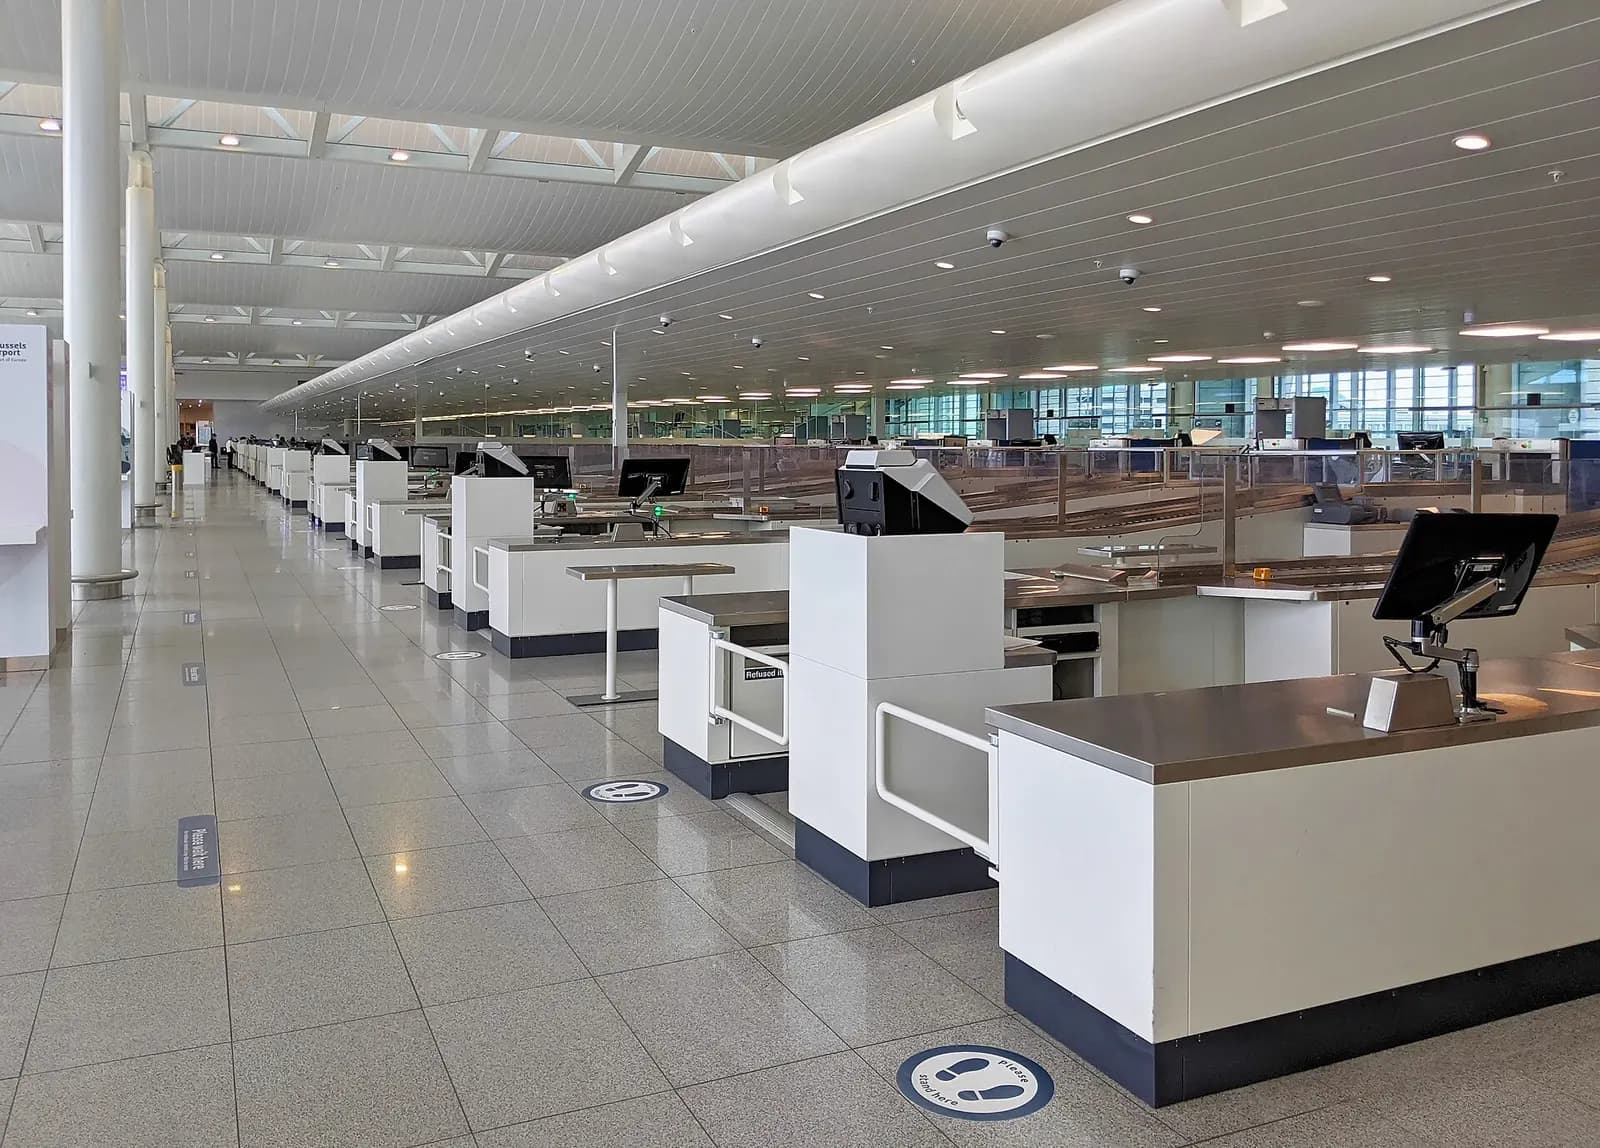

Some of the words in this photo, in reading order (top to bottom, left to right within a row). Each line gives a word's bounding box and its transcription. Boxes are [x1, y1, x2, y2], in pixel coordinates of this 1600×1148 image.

[746, 669, 776, 679] Refused
[191, 828, 208, 846] Please
[192, 845, 208, 857] wait
[192, 856, 208, 870] here
[998, 1060, 1029, 1083] please
[919, 1074, 937, 1093] stand
[931, 1091, 959, 1106] here
